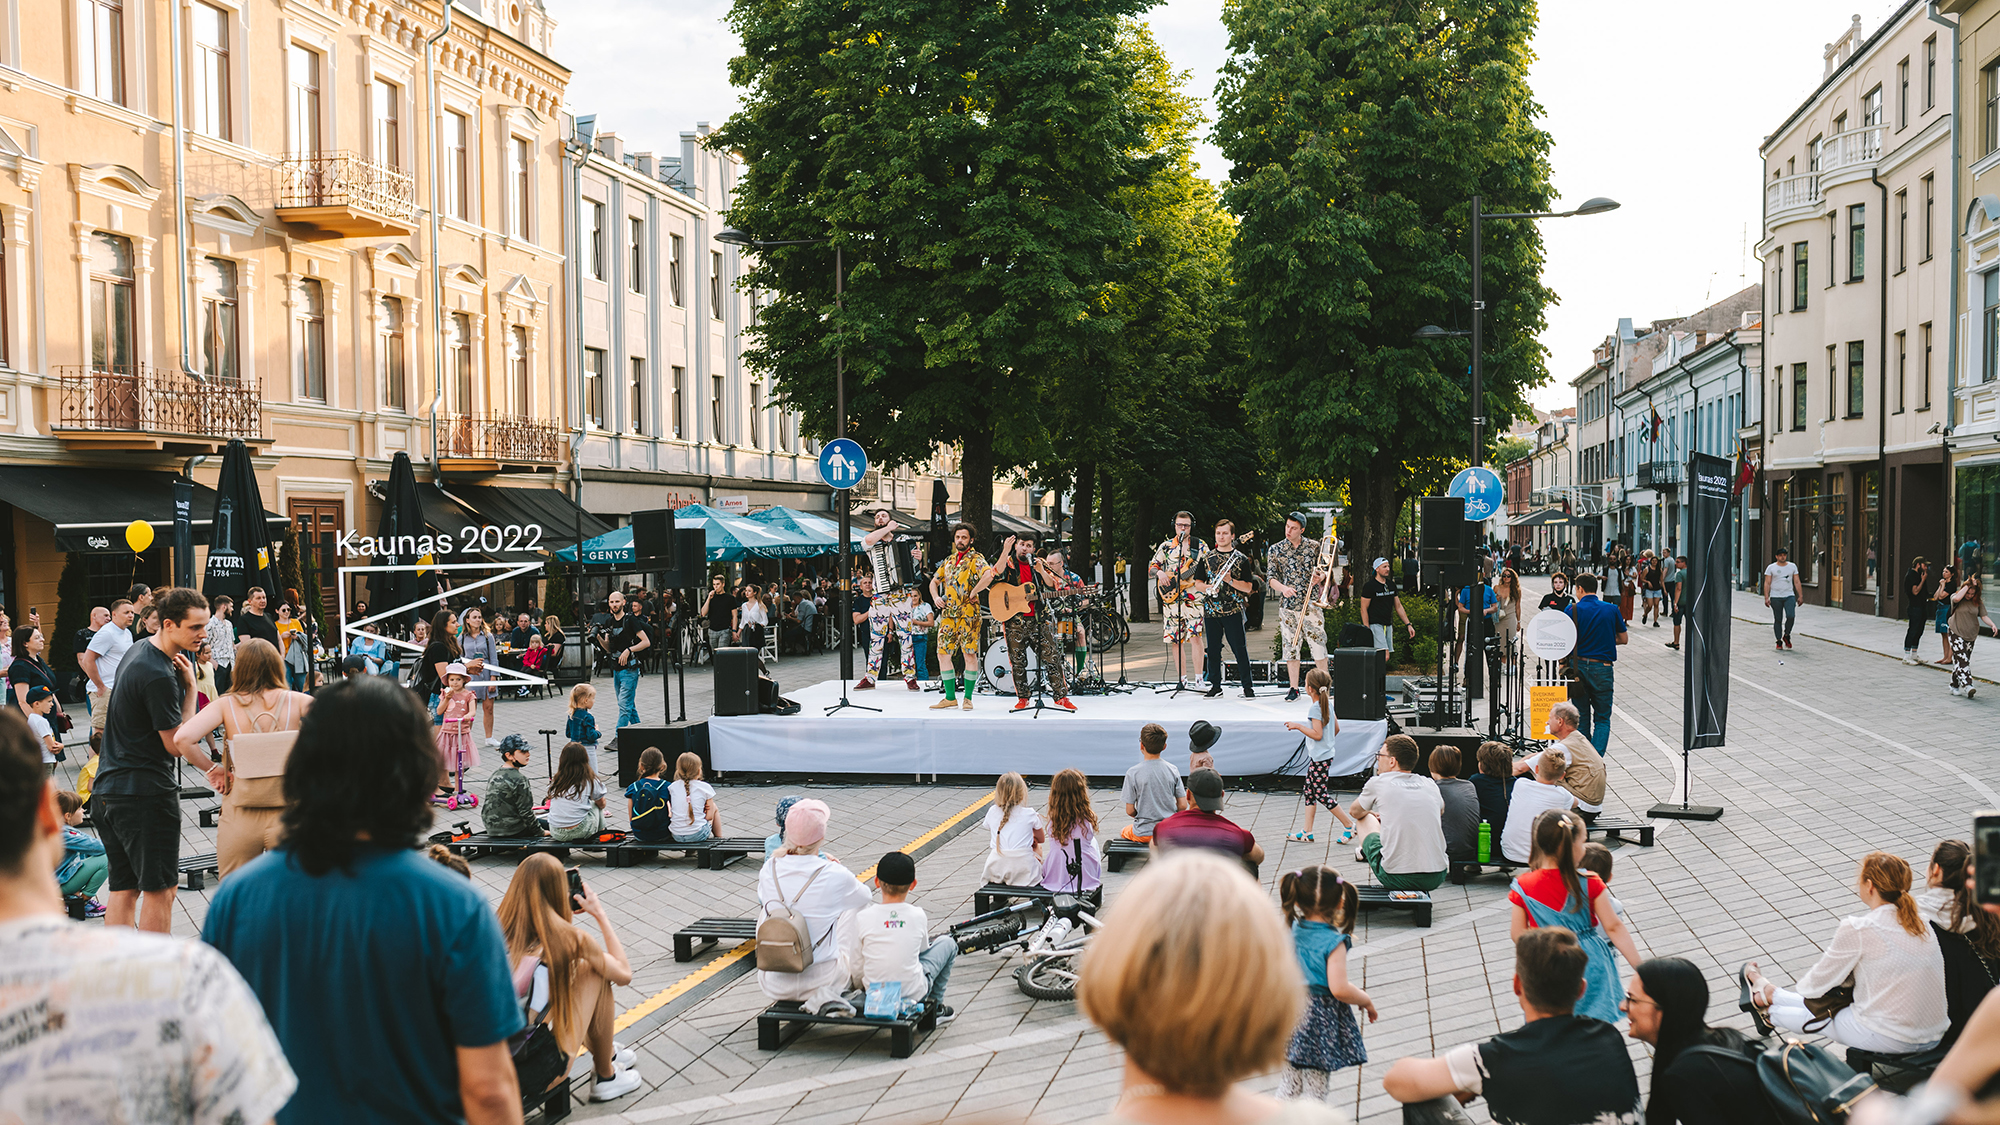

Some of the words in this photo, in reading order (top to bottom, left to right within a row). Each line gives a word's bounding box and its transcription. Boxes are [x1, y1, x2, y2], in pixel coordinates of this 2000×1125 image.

[336, 529, 453, 556] Kaunas
[460, 524, 544, 553] 2022
[589, 550, 629, 561] GENYS
[761, 546, 782, 556] GENYS
[783, 545, 807, 555] BREWING
[212, 569, 230, 577] 1784
